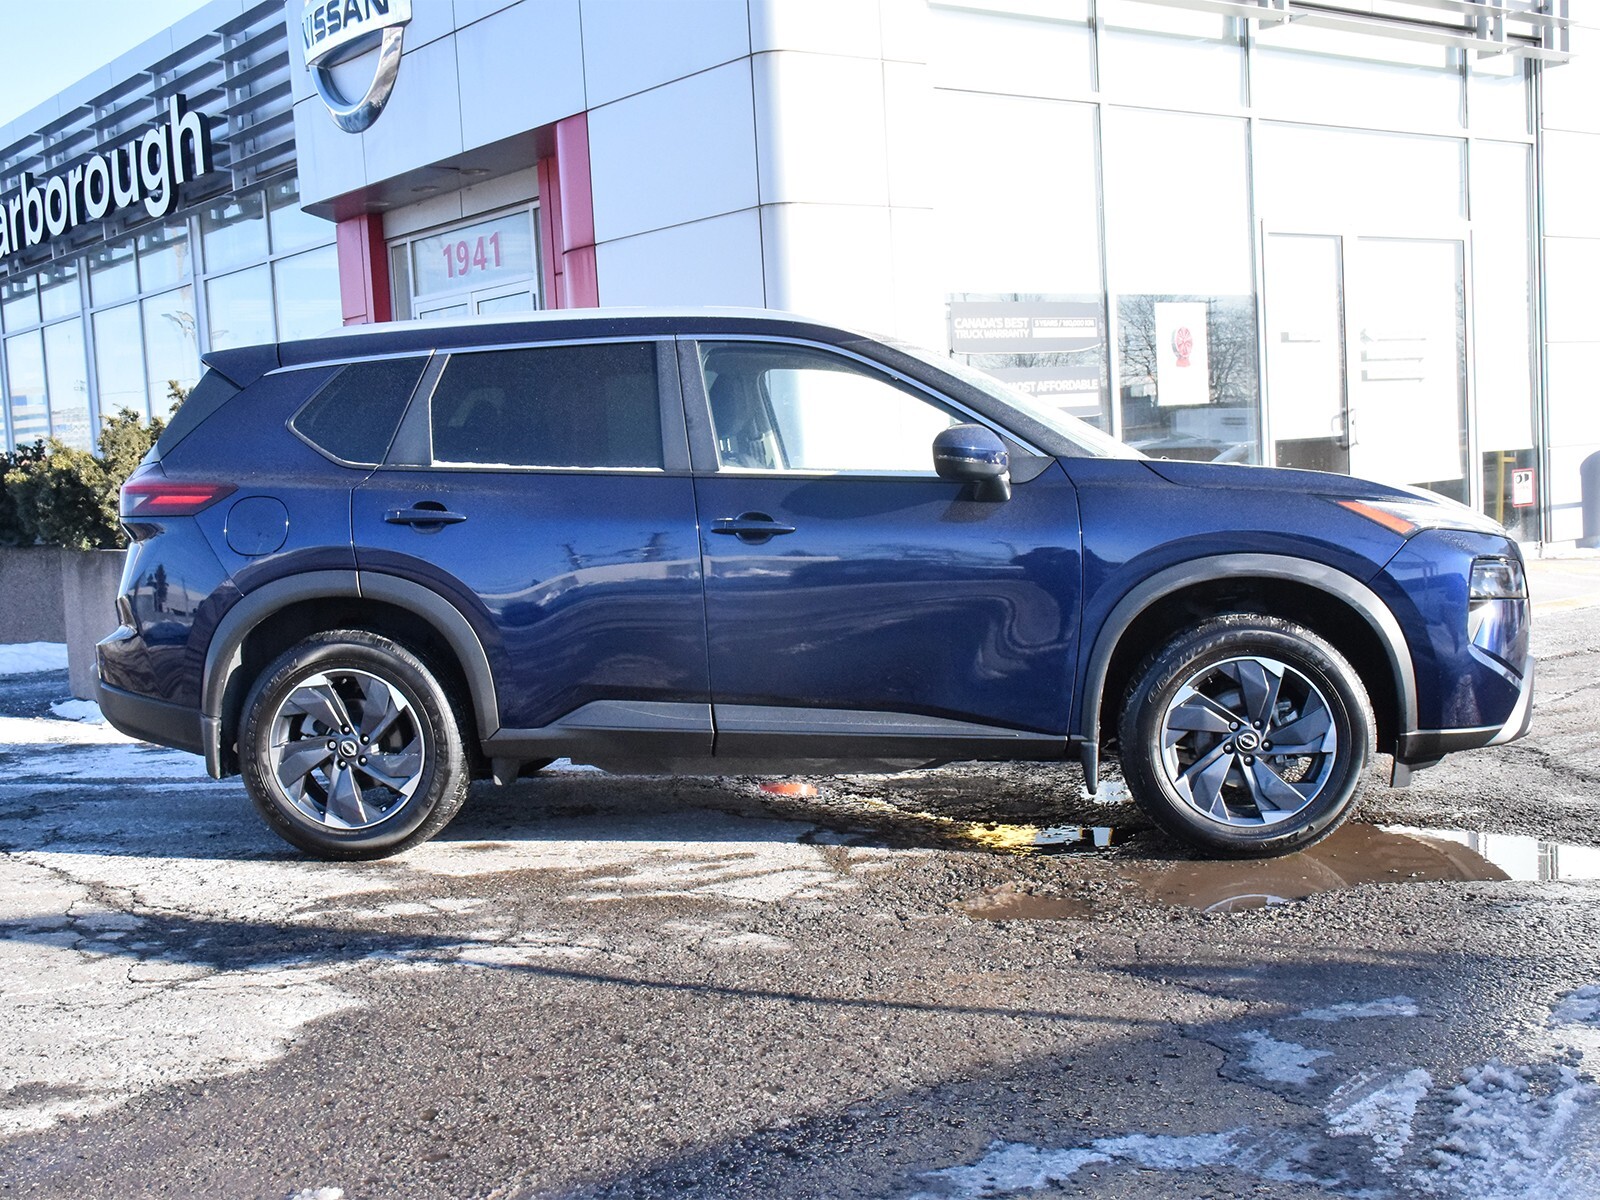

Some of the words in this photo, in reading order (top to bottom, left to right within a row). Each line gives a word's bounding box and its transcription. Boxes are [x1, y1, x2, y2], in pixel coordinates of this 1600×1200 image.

[443, 231, 501, 278] 1941
[954, 317, 1003, 329] CANADA'S
[1004, 317, 1029, 329] BEST
[955, 329, 983, 339] TRUCK
[983, 328, 1030, 338] WARRANTY
[1037, 379, 1099, 392] AFFORDABLE
